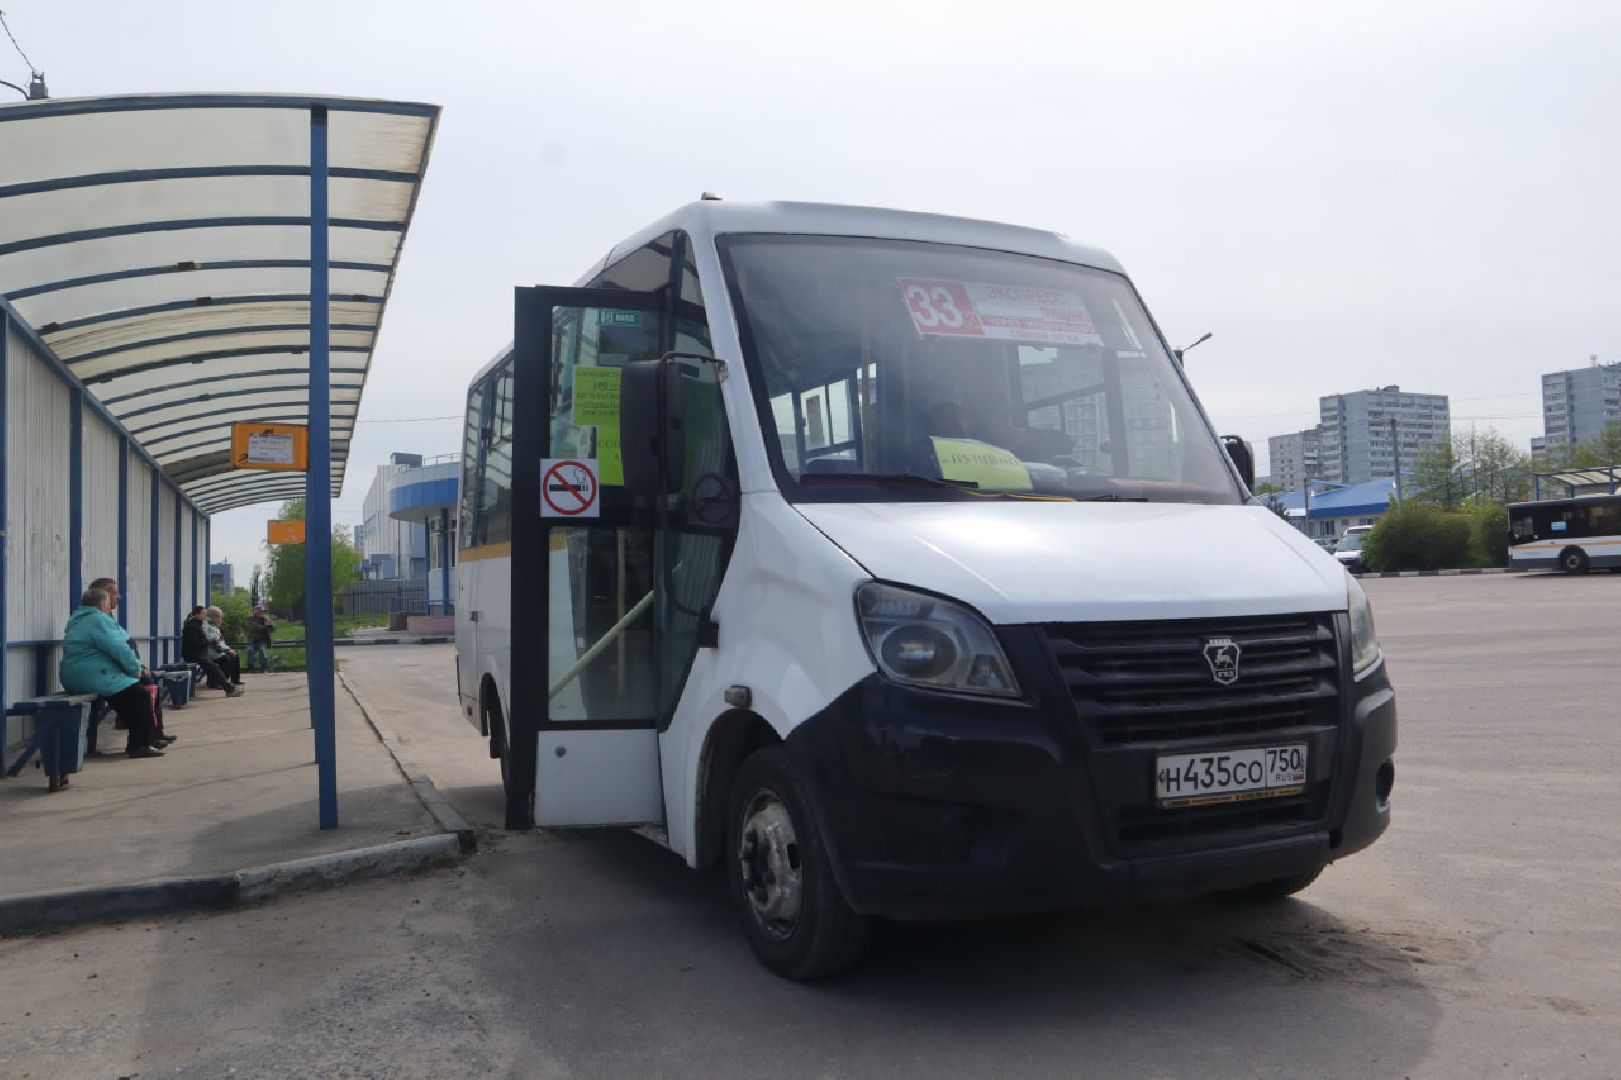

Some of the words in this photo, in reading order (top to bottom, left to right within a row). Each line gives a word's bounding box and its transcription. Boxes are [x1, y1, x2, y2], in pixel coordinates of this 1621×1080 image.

[907, 285, 963, 328] 33
[1166, 756, 1263, 792] Н435СО
[1267, 749, 1301, 773] 750
[1275, 773, 1292, 783] RUS
